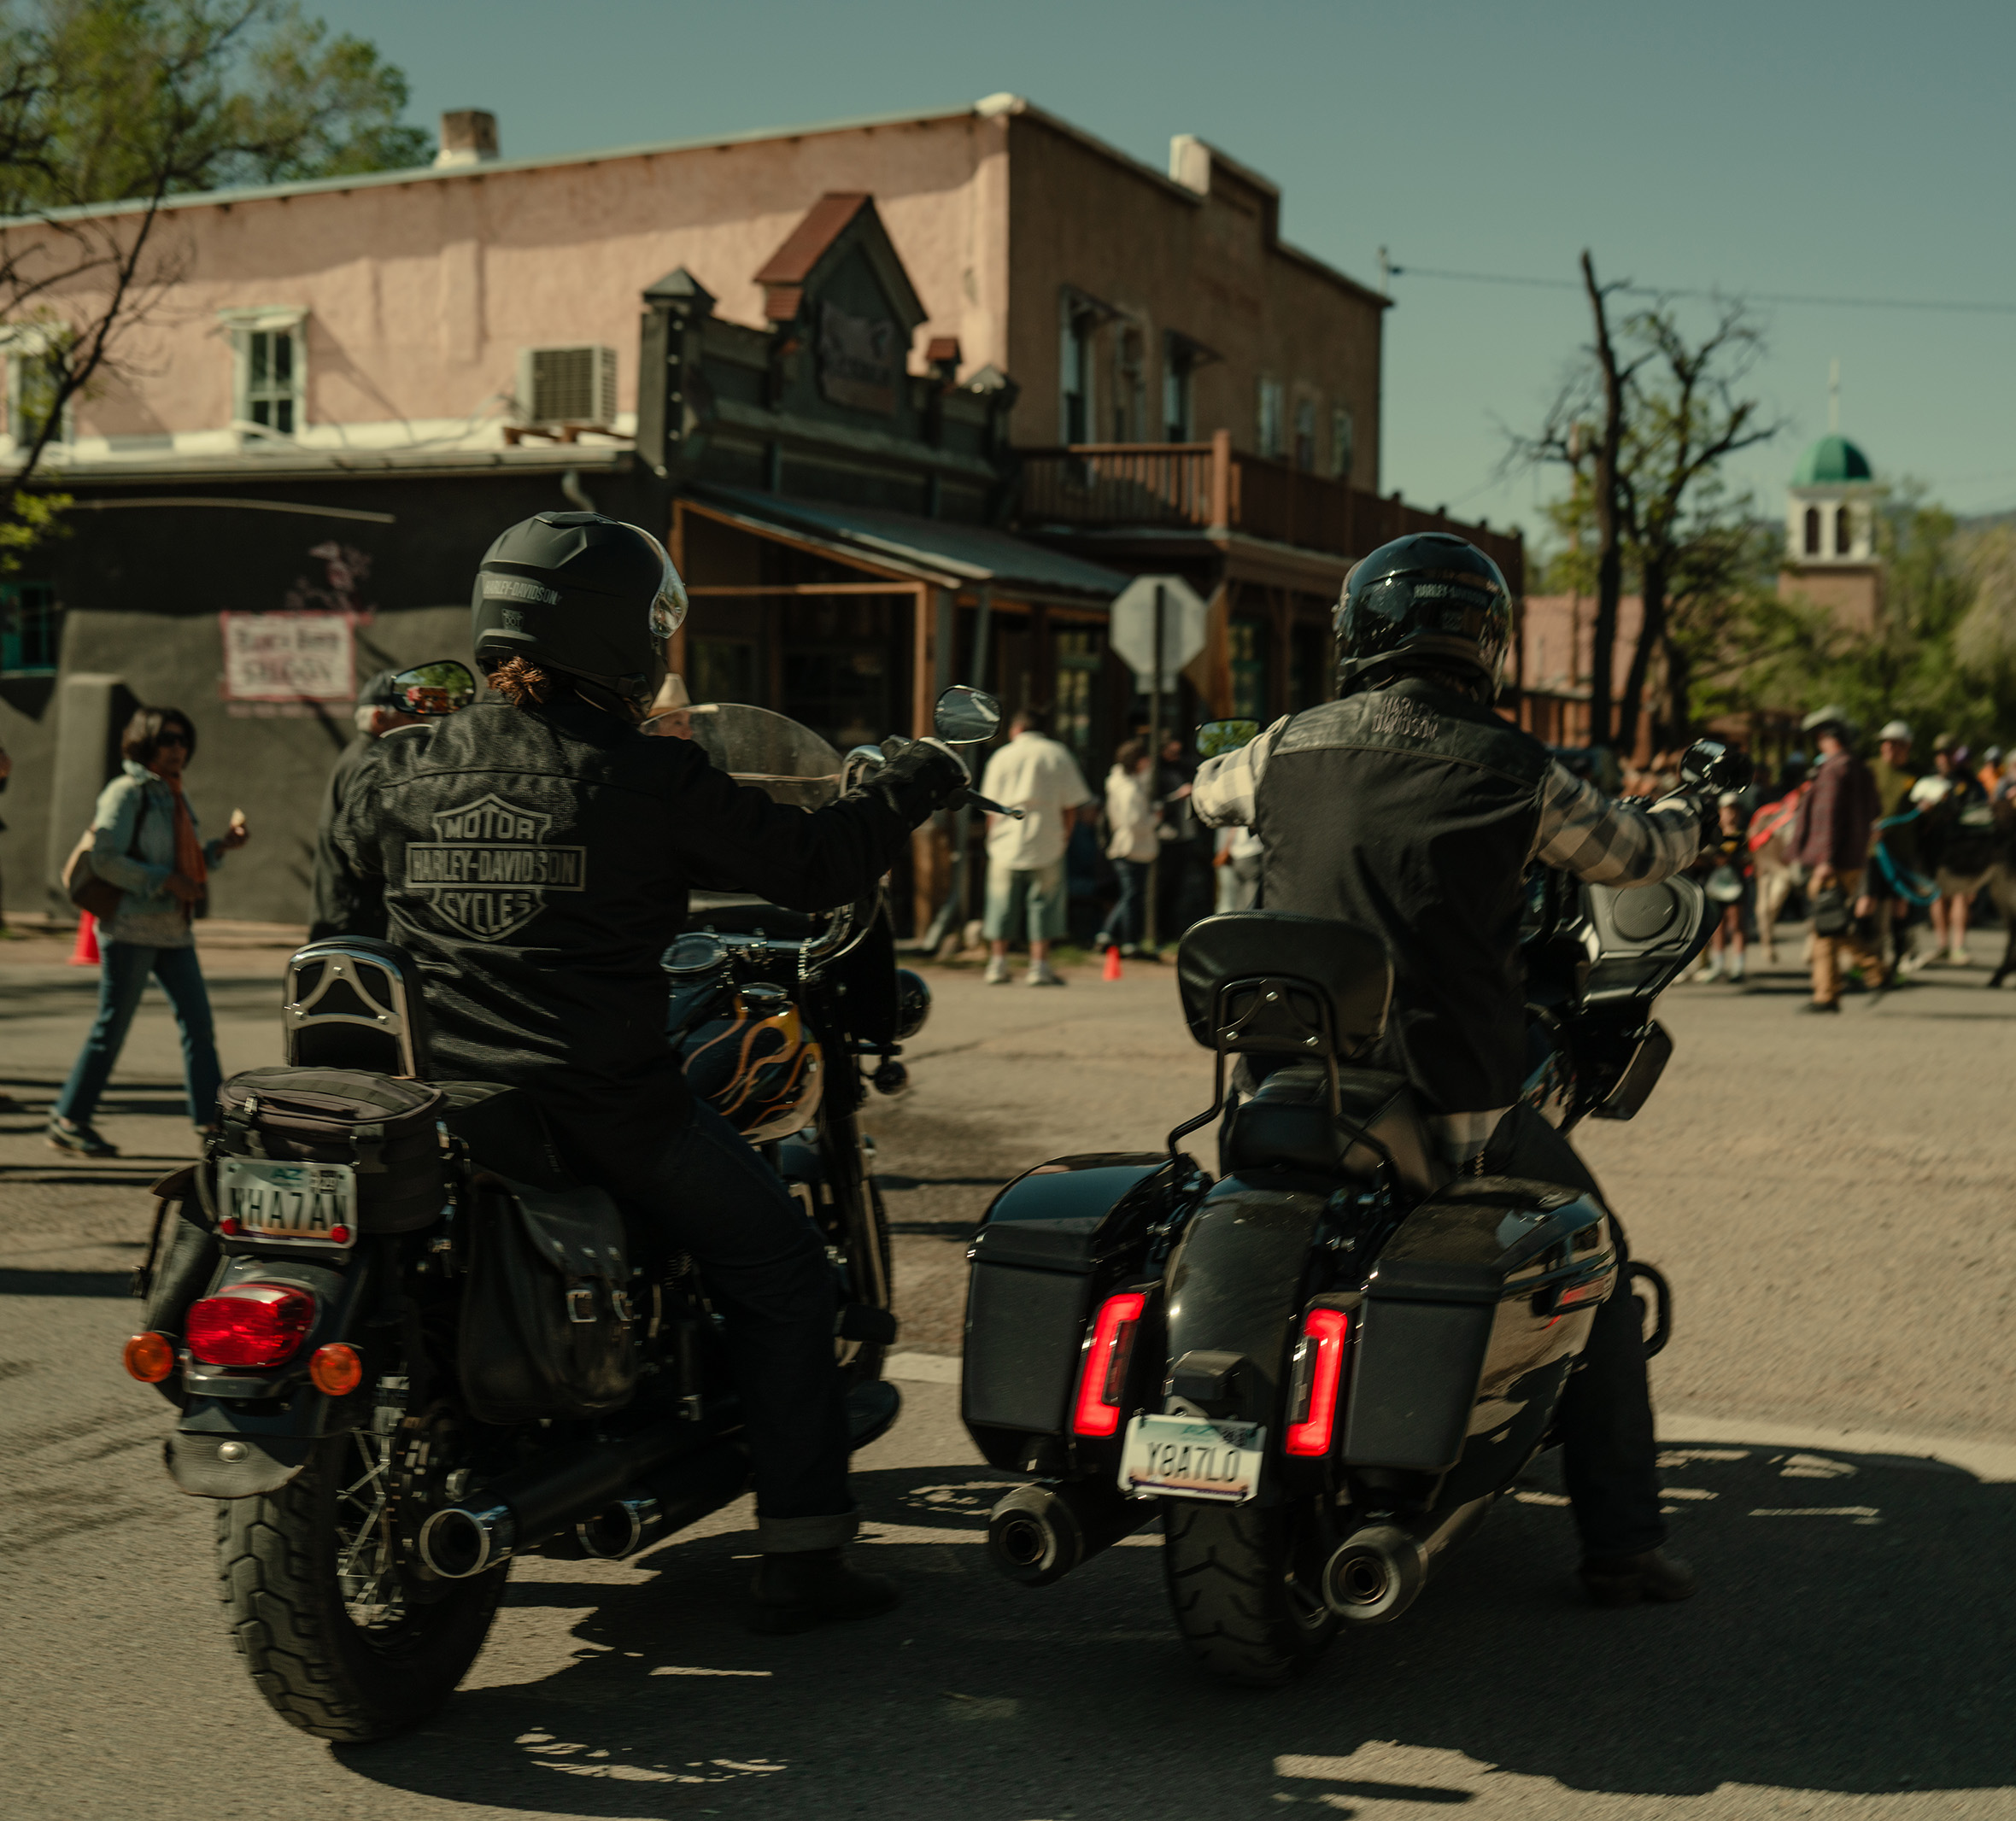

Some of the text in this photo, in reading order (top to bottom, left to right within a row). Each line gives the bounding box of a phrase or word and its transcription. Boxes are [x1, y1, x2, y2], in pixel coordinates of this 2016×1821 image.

[483, 580, 559, 606] HARLEY-DAVIDSON
[444, 803, 536, 840] MOTOR
[411, 849, 576, 884] HARLEY-DAVIDSON
[442, 891, 531, 934] CYCLES
